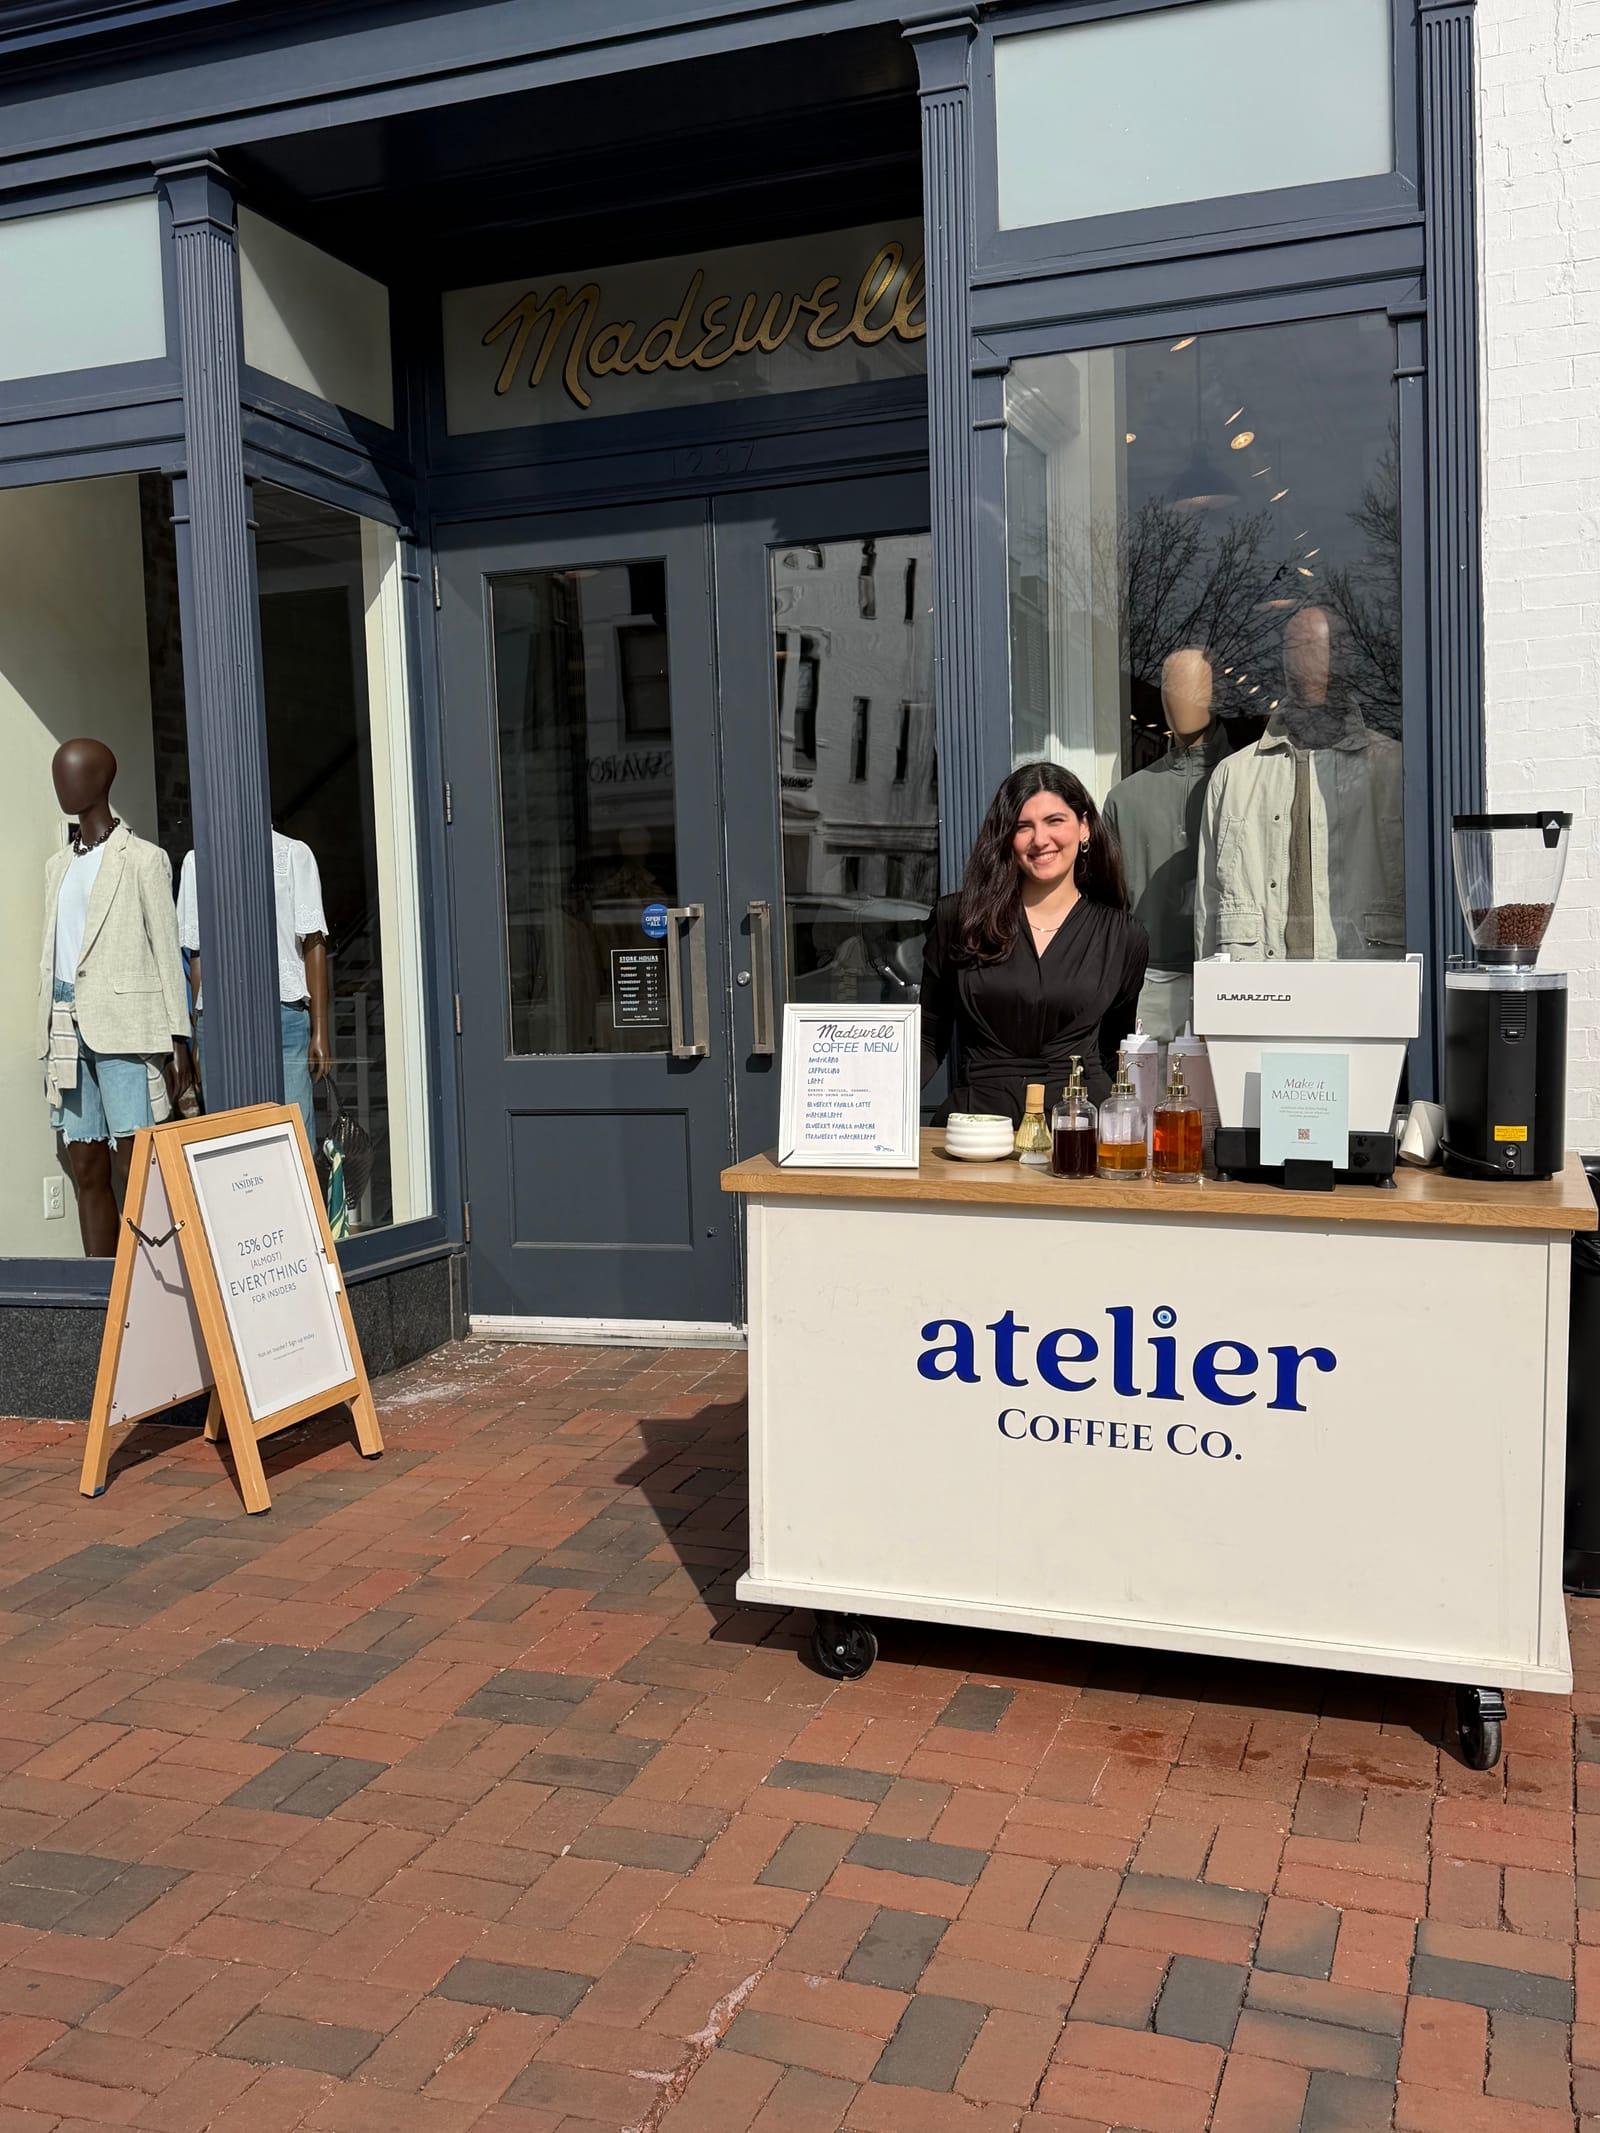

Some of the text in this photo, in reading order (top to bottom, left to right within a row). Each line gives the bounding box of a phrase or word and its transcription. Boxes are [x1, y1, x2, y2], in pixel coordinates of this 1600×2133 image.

[481, 240, 927, 409] Madewell
[816, 1024, 895, 1042] Madewell
[812, 1042, 899, 1052] COFFEE MENU
[1284, 1078, 1325, 1089] Make it
[1272, 1090, 1337, 1102] MADEWELL
[232, 1176, 264, 1191] INSIDERS
[238, 1230, 284, 1256] 25% OFF
[250, 1252, 282, 1269] (ALMOST)
[230, 1259, 308, 1296] EVERYTHING
[252, 1282, 297, 1304] FOR INSIDERS
[917, 1305, 1337, 1412] atelier
[998, 1409, 1242, 1461] COFFEE CO.
